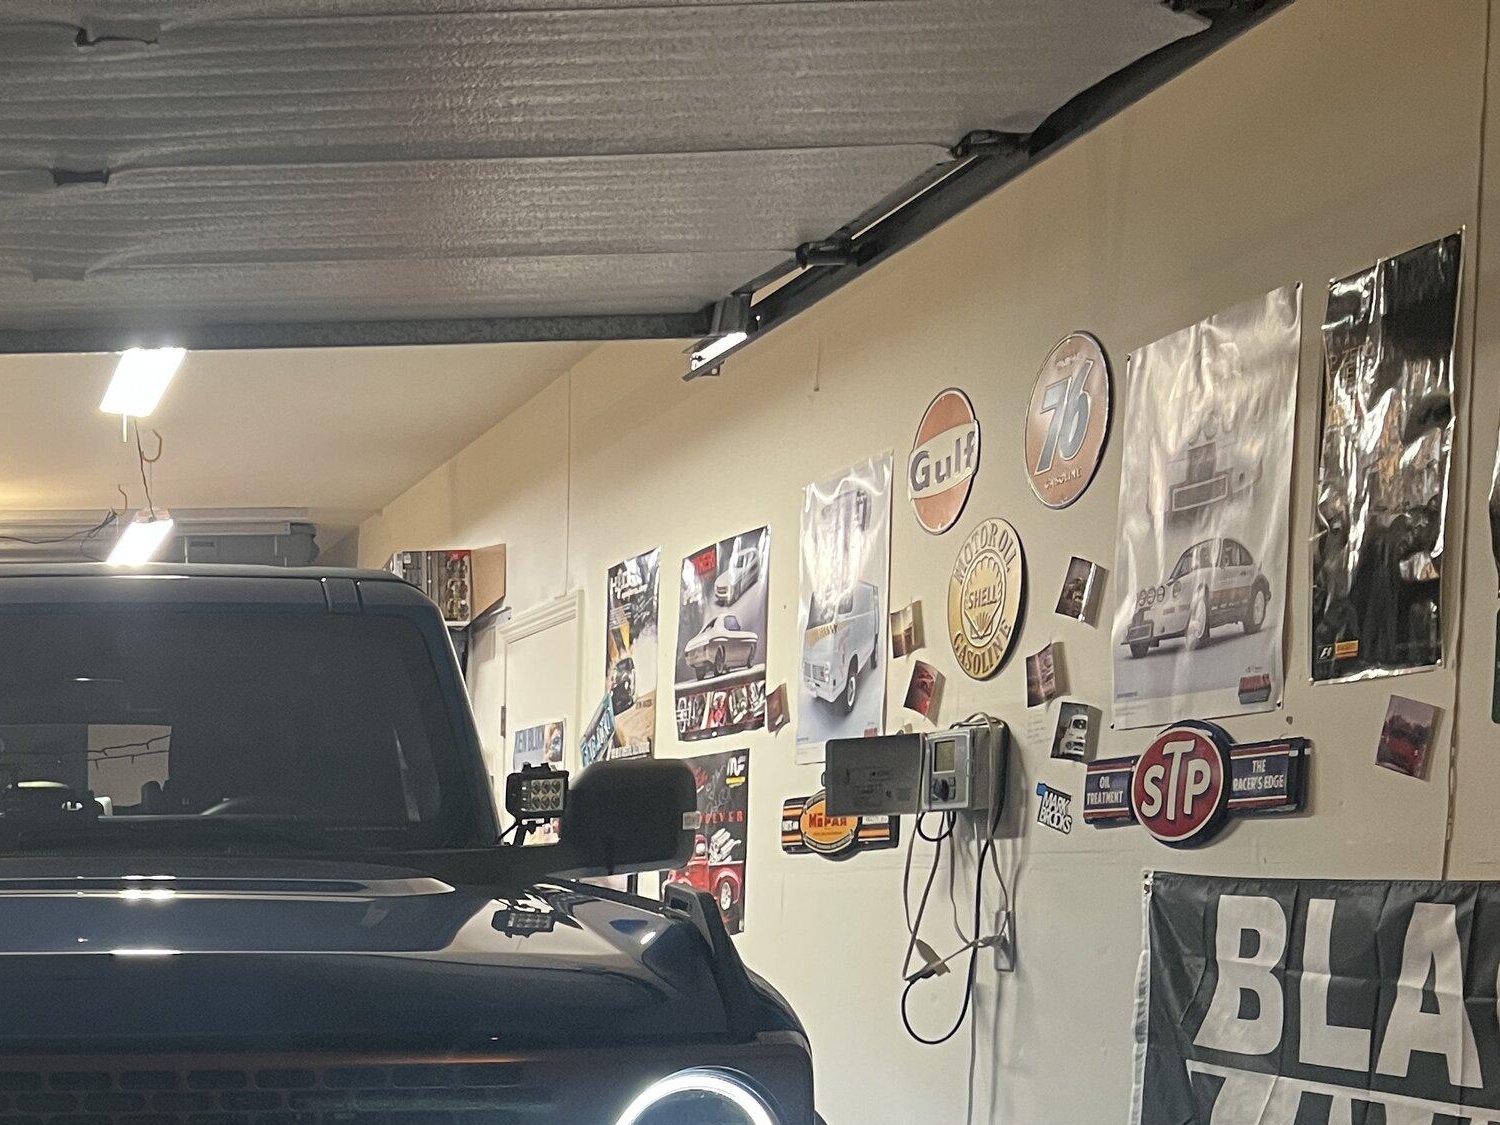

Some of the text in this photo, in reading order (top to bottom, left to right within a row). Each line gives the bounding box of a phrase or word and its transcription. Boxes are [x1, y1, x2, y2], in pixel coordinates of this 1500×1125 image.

[1033, 357, 1095, 476] 76
[909, 430, 976, 493] Gulf
[954, 521, 1019, 586] MOTOR OIL
[968, 585, 998, 610] SHELL
[953, 617, 1011, 676] GASOLINE
[1252, 758, 1267, 774] THE
[1099, 776, 1111, 789] OIL
[1140, 740, 1212, 821] STP
[1232, 774, 1284, 792] RACER'S EDGE
[1042, 790, 1071, 816] MARK
[1087, 789, 1124, 805] TREATMENT
[1040, 807, 1073, 835] BROOKS
[1192, 894, 1500, 1089] BLA
